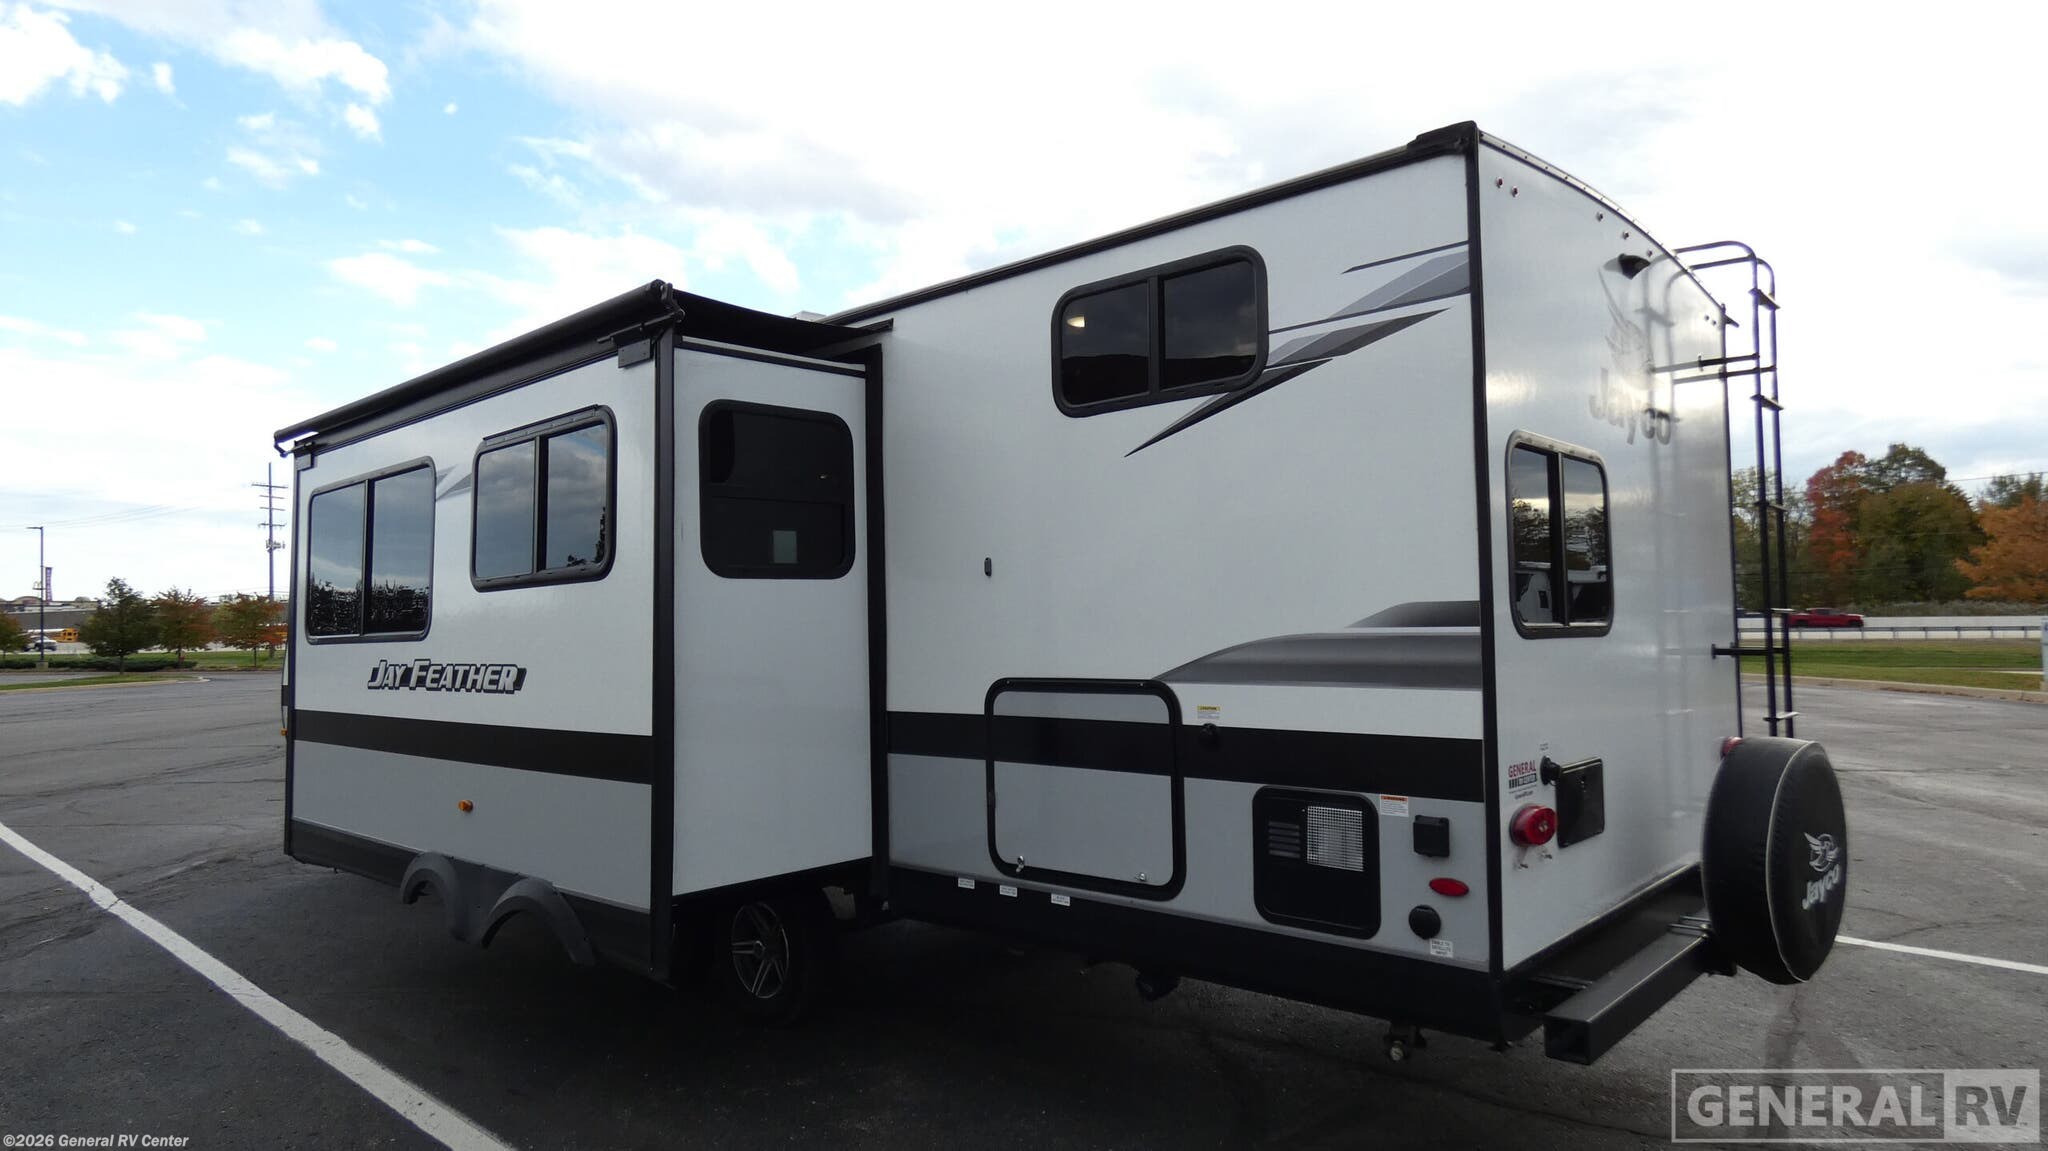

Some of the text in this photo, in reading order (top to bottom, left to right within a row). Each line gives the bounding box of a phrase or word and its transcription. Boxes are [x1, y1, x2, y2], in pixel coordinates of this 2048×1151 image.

[1588, 367, 1672, 446] Jayco
[367, 658, 518, 694] JAY FEATHER
[1508, 760, 1537, 778] GENERAL
[1802, 864, 1840, 910] Jayco
